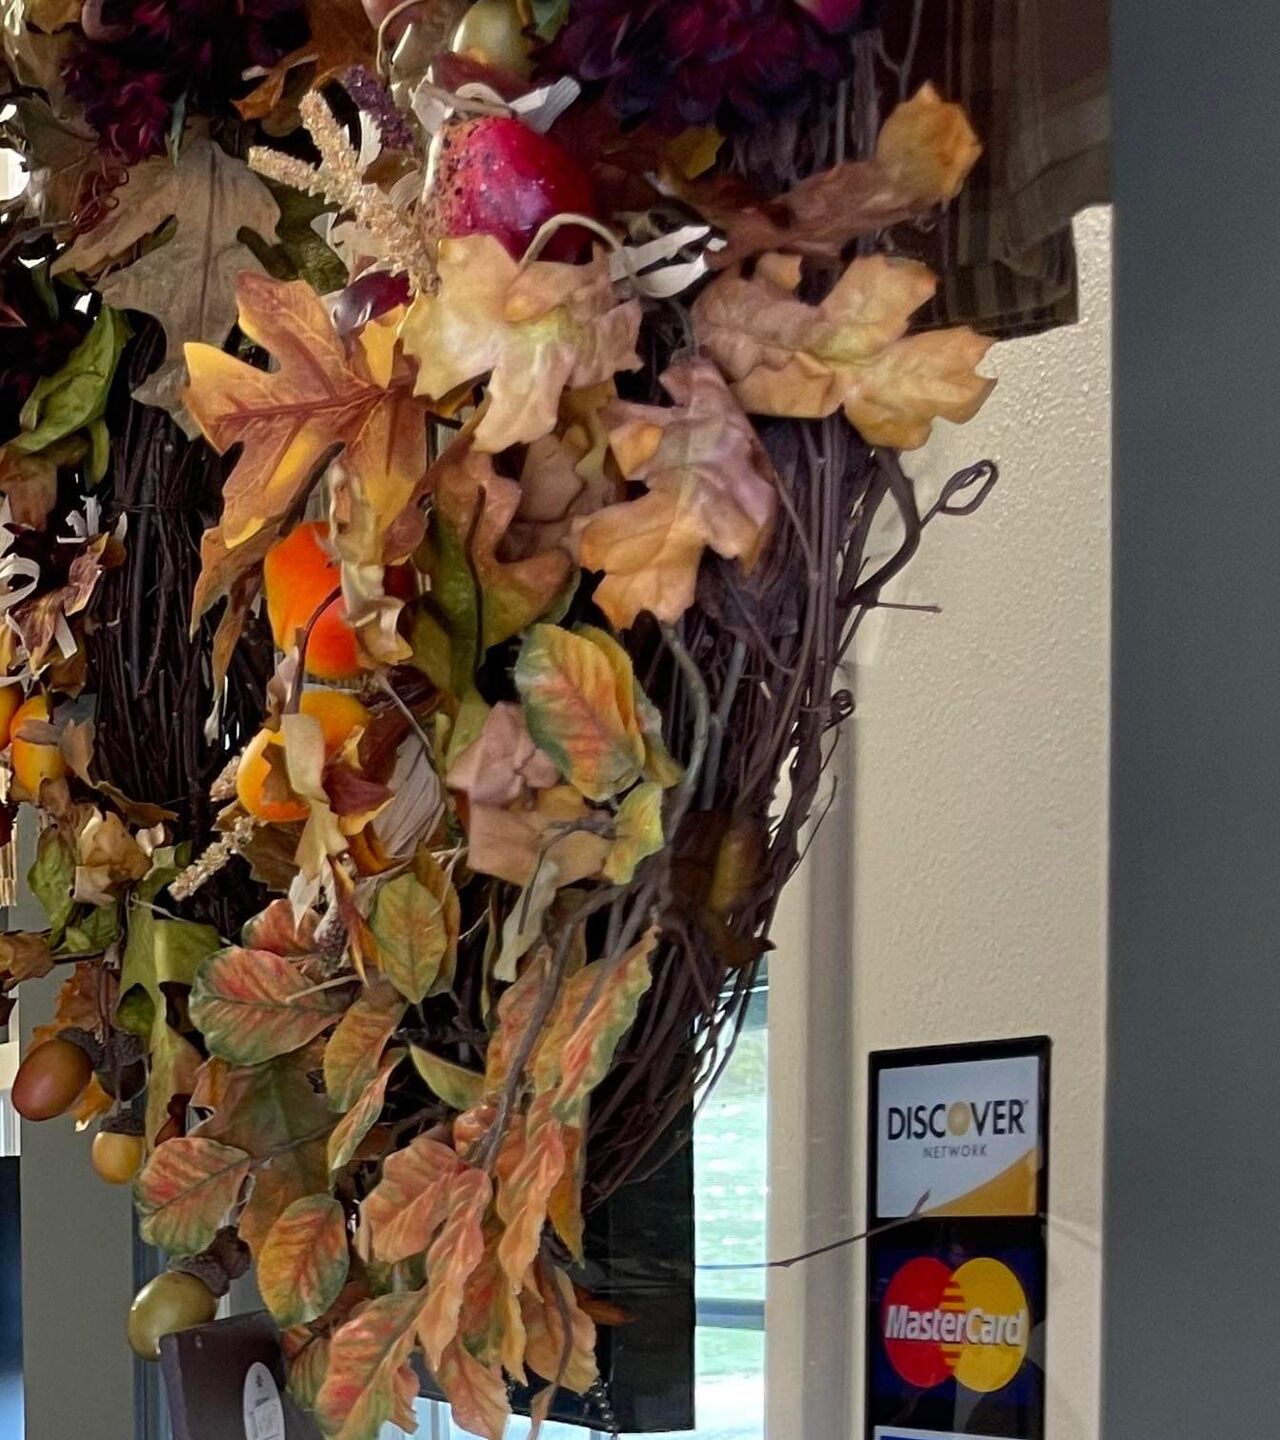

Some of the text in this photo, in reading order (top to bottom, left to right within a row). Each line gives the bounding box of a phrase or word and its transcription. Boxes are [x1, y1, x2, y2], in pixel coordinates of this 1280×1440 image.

[887, 1097, 1026, 1142] DISCOVER
[922, 1143, 988, 1159] NETWORK
[885, 1304, 1026, 1347] MasterCard
